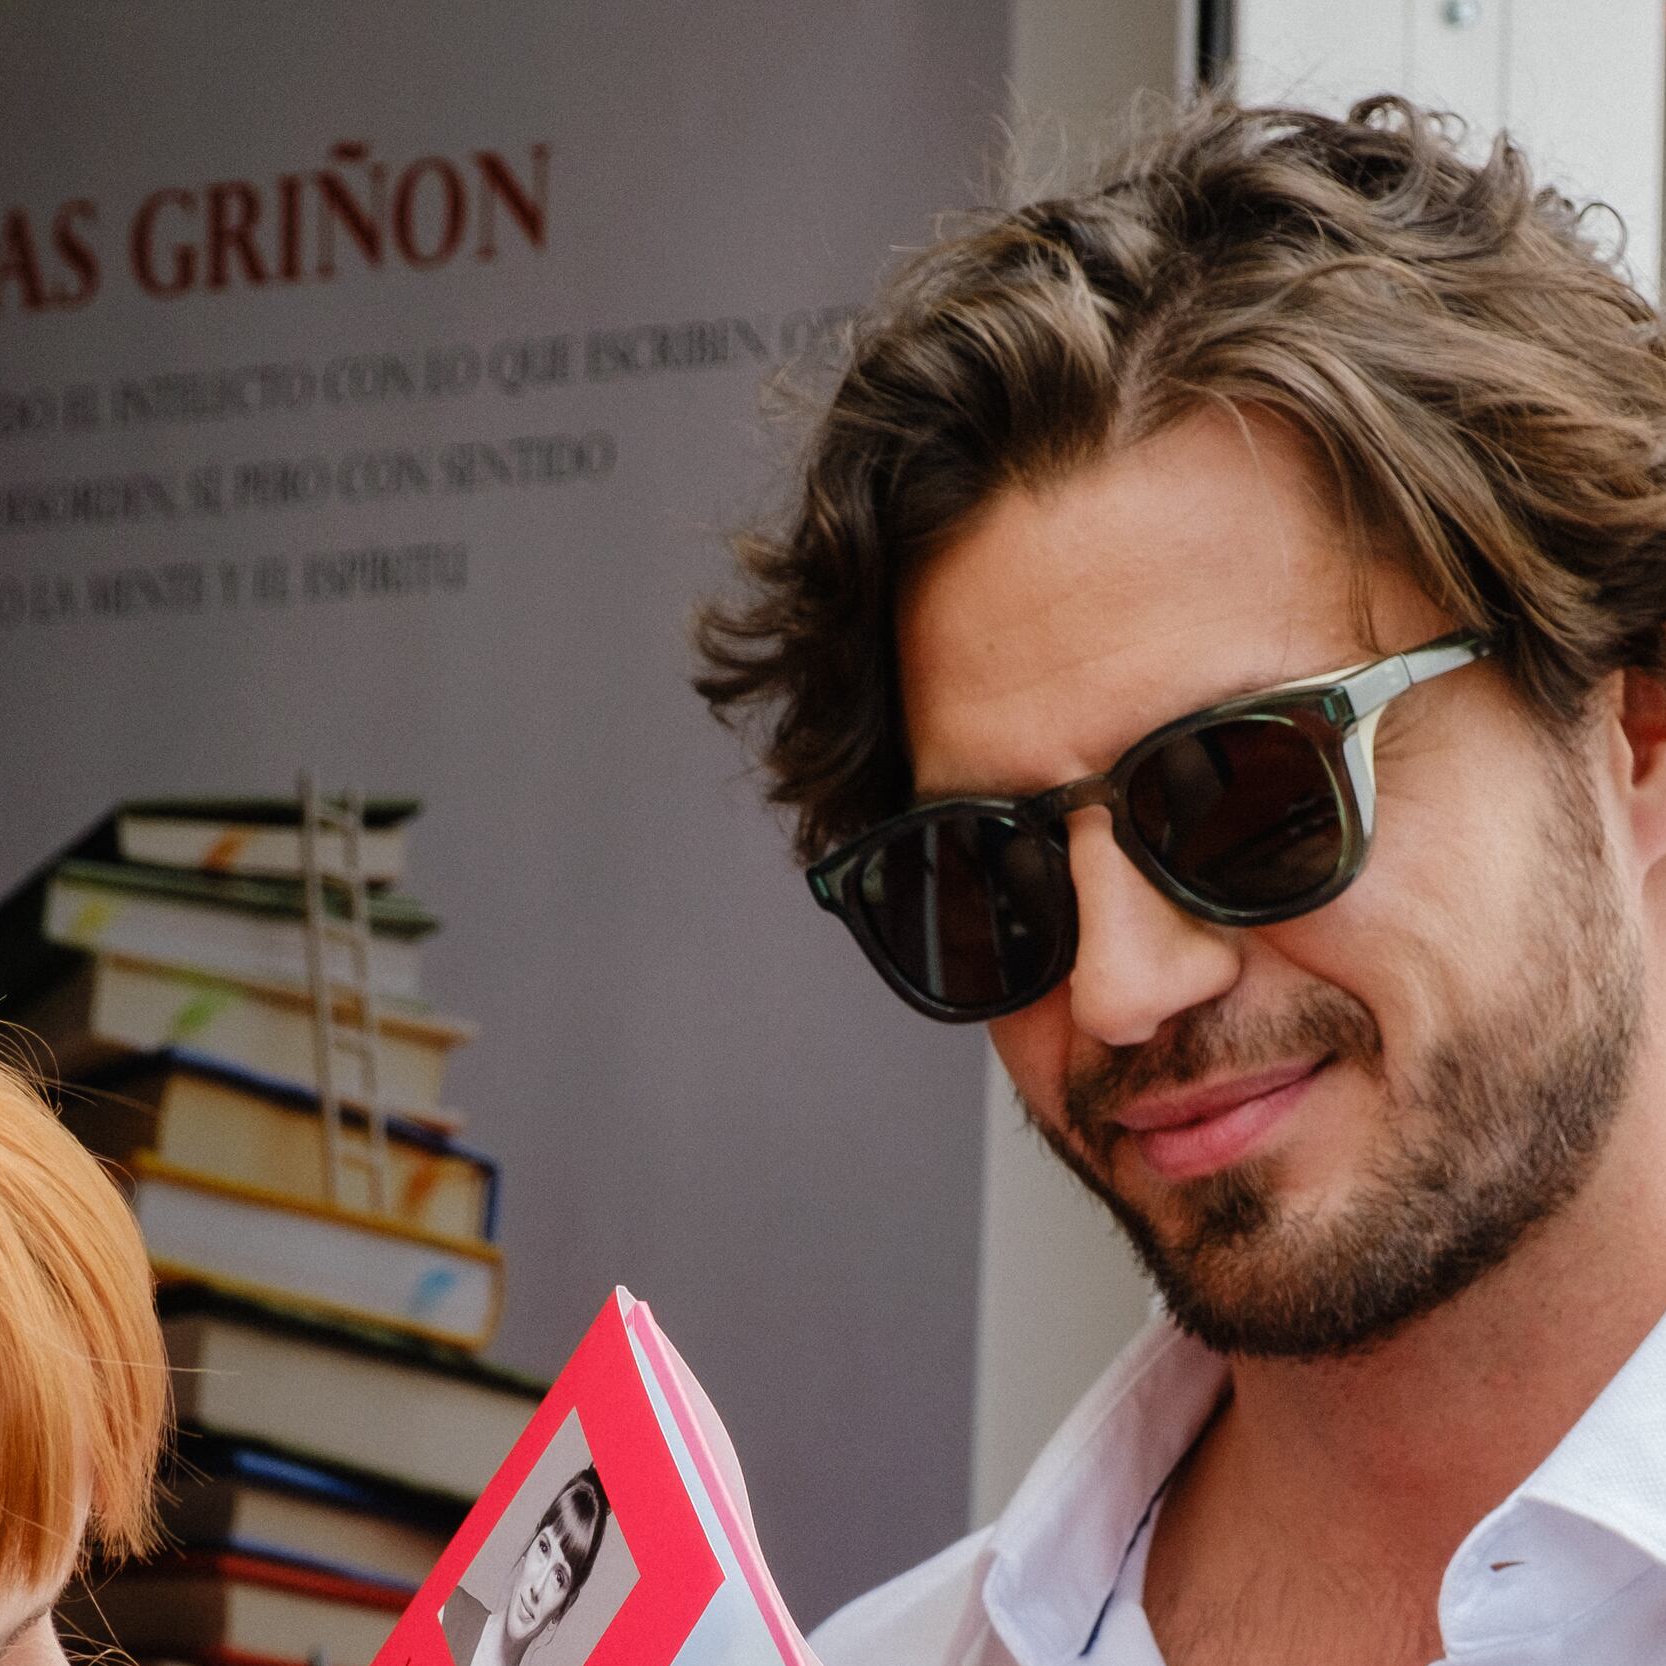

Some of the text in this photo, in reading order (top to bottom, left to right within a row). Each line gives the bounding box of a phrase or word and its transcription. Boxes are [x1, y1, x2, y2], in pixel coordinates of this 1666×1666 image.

[128, 140, 552, 301] GRIÑON
[325, 347, 416, 406] CON
[424, 346, 480, 400] LO
[487, 331, 572, 395] QUE
[337, 449, 432, 501] CON
[438, 430, 618, 494] SENTIDO
